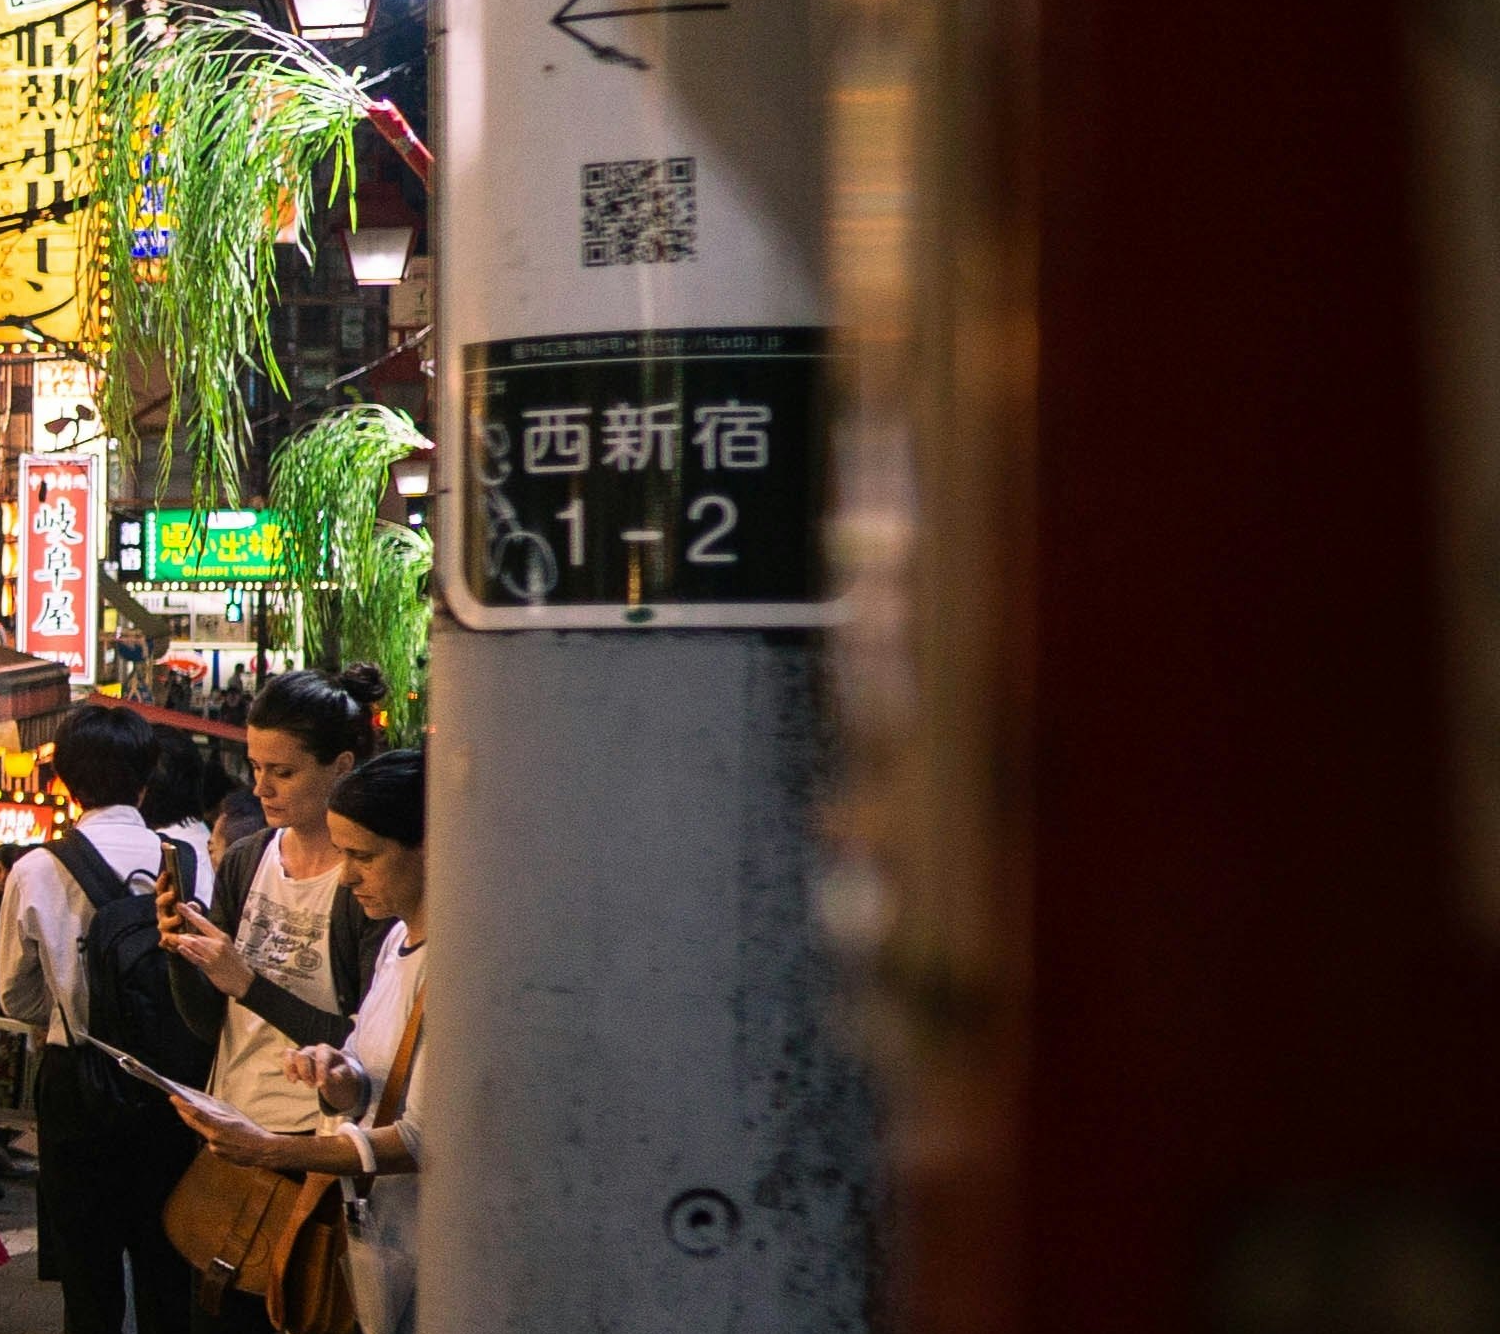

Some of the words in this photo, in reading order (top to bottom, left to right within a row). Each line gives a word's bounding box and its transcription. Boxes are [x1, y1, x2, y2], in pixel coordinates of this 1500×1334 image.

[521, 399, 773, 474] 西新宿
[161, 522, 303, 565] 思い出横
